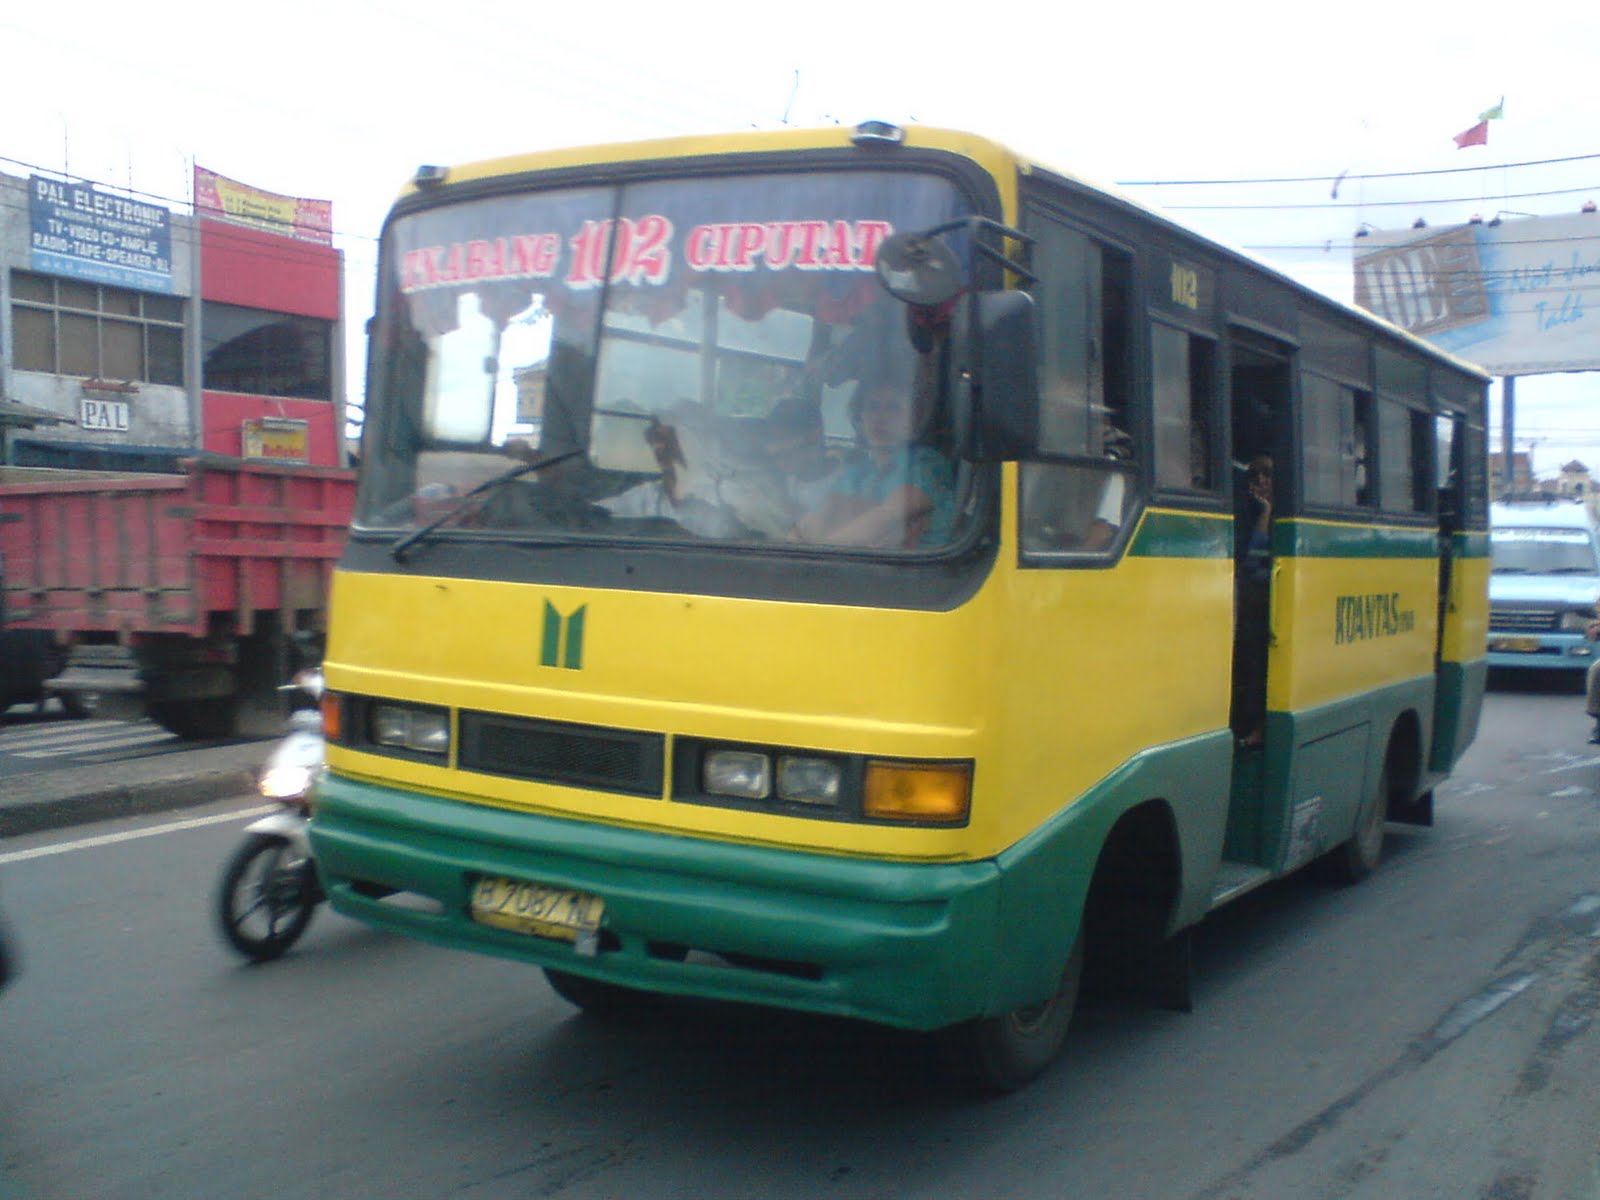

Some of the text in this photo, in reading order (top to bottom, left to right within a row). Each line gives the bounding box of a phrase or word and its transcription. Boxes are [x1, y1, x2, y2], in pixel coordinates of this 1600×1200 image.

[36, 180, 68, 206] PAL
[74, 189, 165, 227] ELECTRONIC
[564, 214, 673, 291] 102
[686, 219, 894, 273] CIPUTAT
[84, 402, 128, 430] PAL
